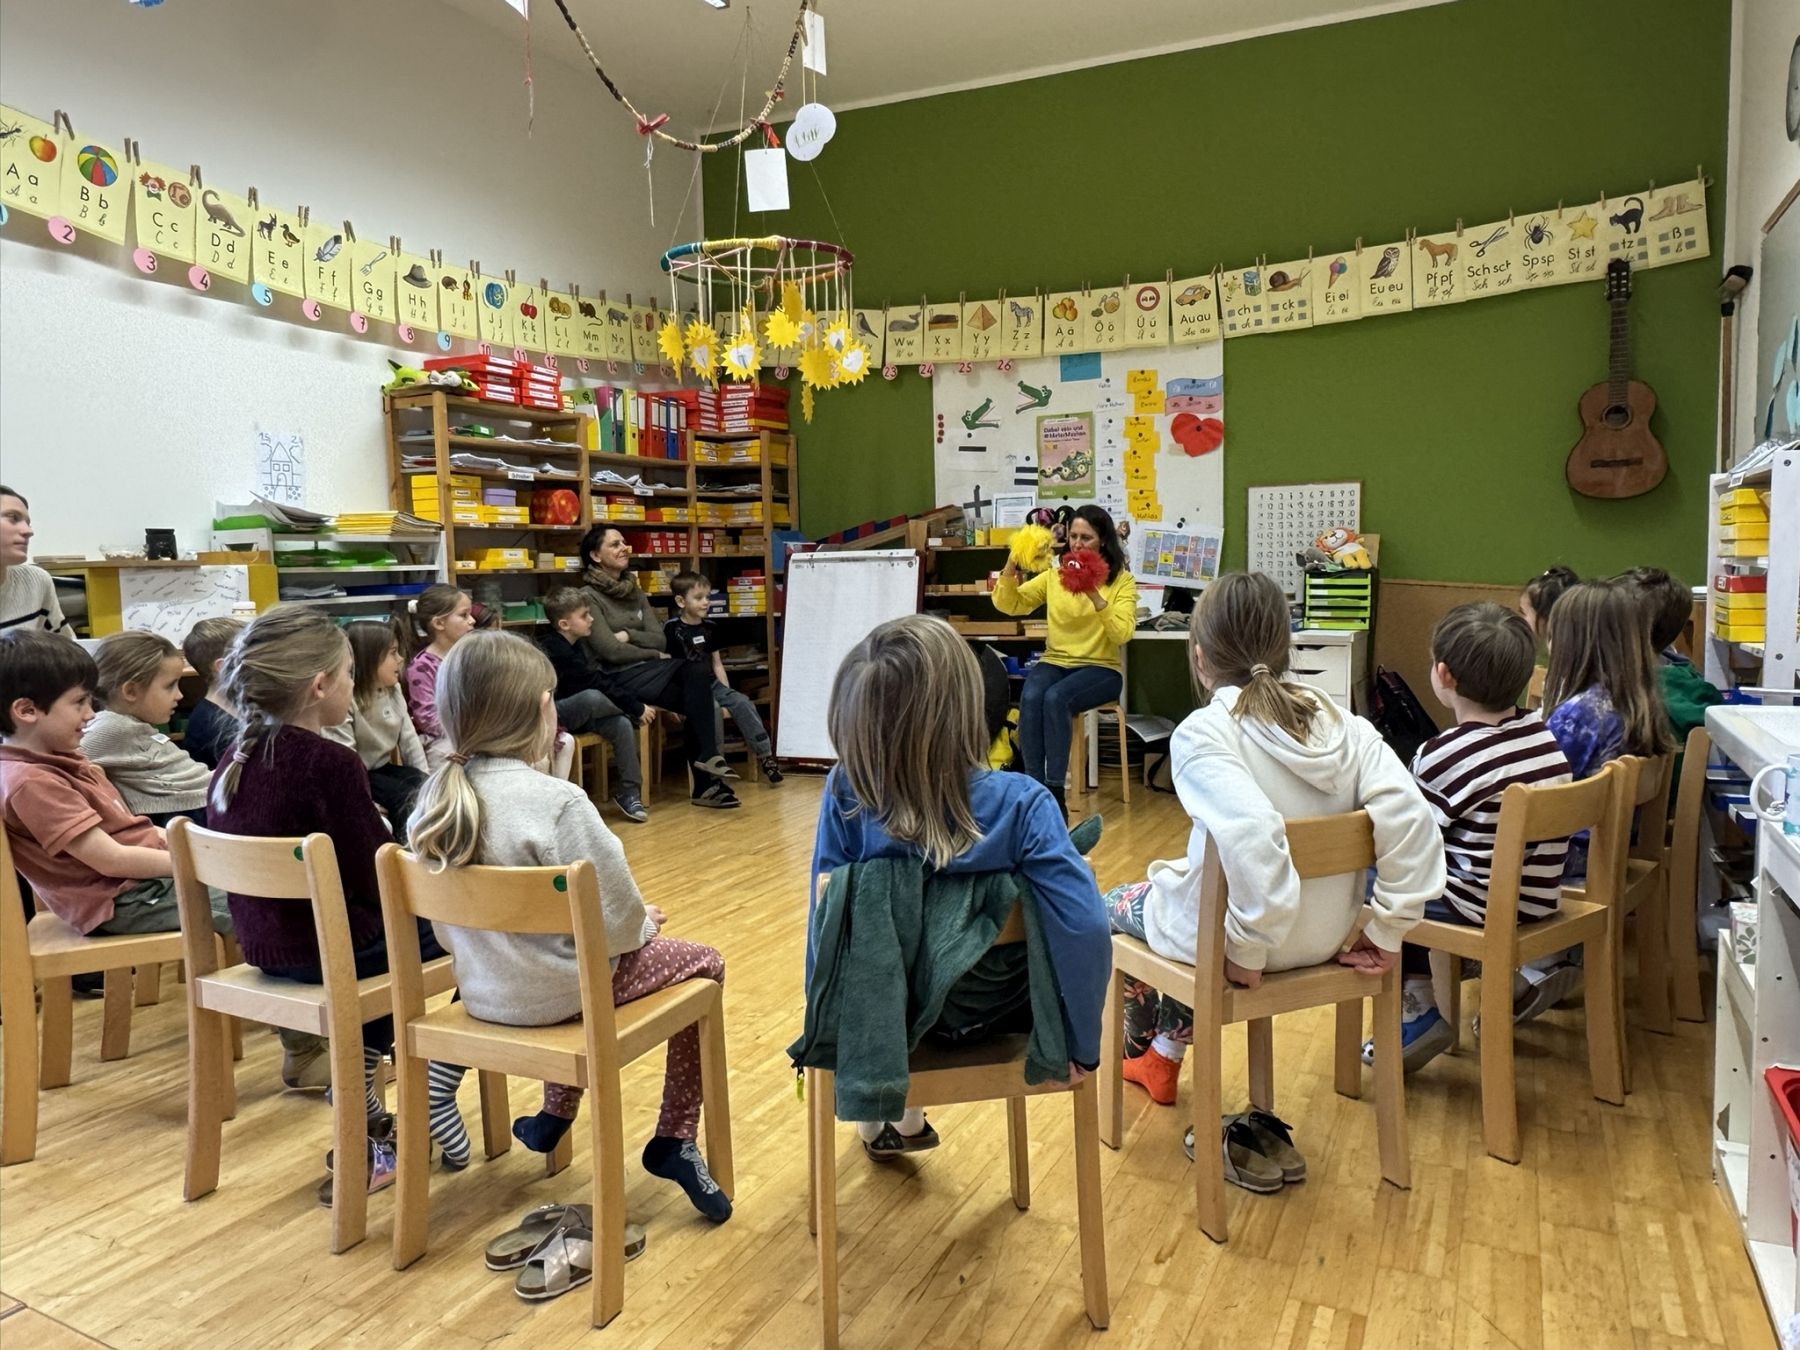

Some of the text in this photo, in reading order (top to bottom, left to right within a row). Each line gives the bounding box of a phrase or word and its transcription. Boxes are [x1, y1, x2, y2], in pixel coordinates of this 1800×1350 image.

[63, 226, 73, 242] 2
[147, 256, 155, 271] 3
[200, 274, 208, 288] 4
[264, 290, 271, 303] 5
[313, 304, 320, 317] 6
[360, 317, 365, 330] 7
[407, 328, 413, 340] 8
[445, 335, 450, 347] 9
[516, 350, 527, 362] 11
[547, 357, 557, 367] 12
[579, 360, 589, 370] 13
[922, 364, 933, 375] 24
[960, 362, 972, 373] 25
[999, 360, 1011, 370] 26
[777, 368, 787, 378] 20
[884, 367, 897, 378] 23
